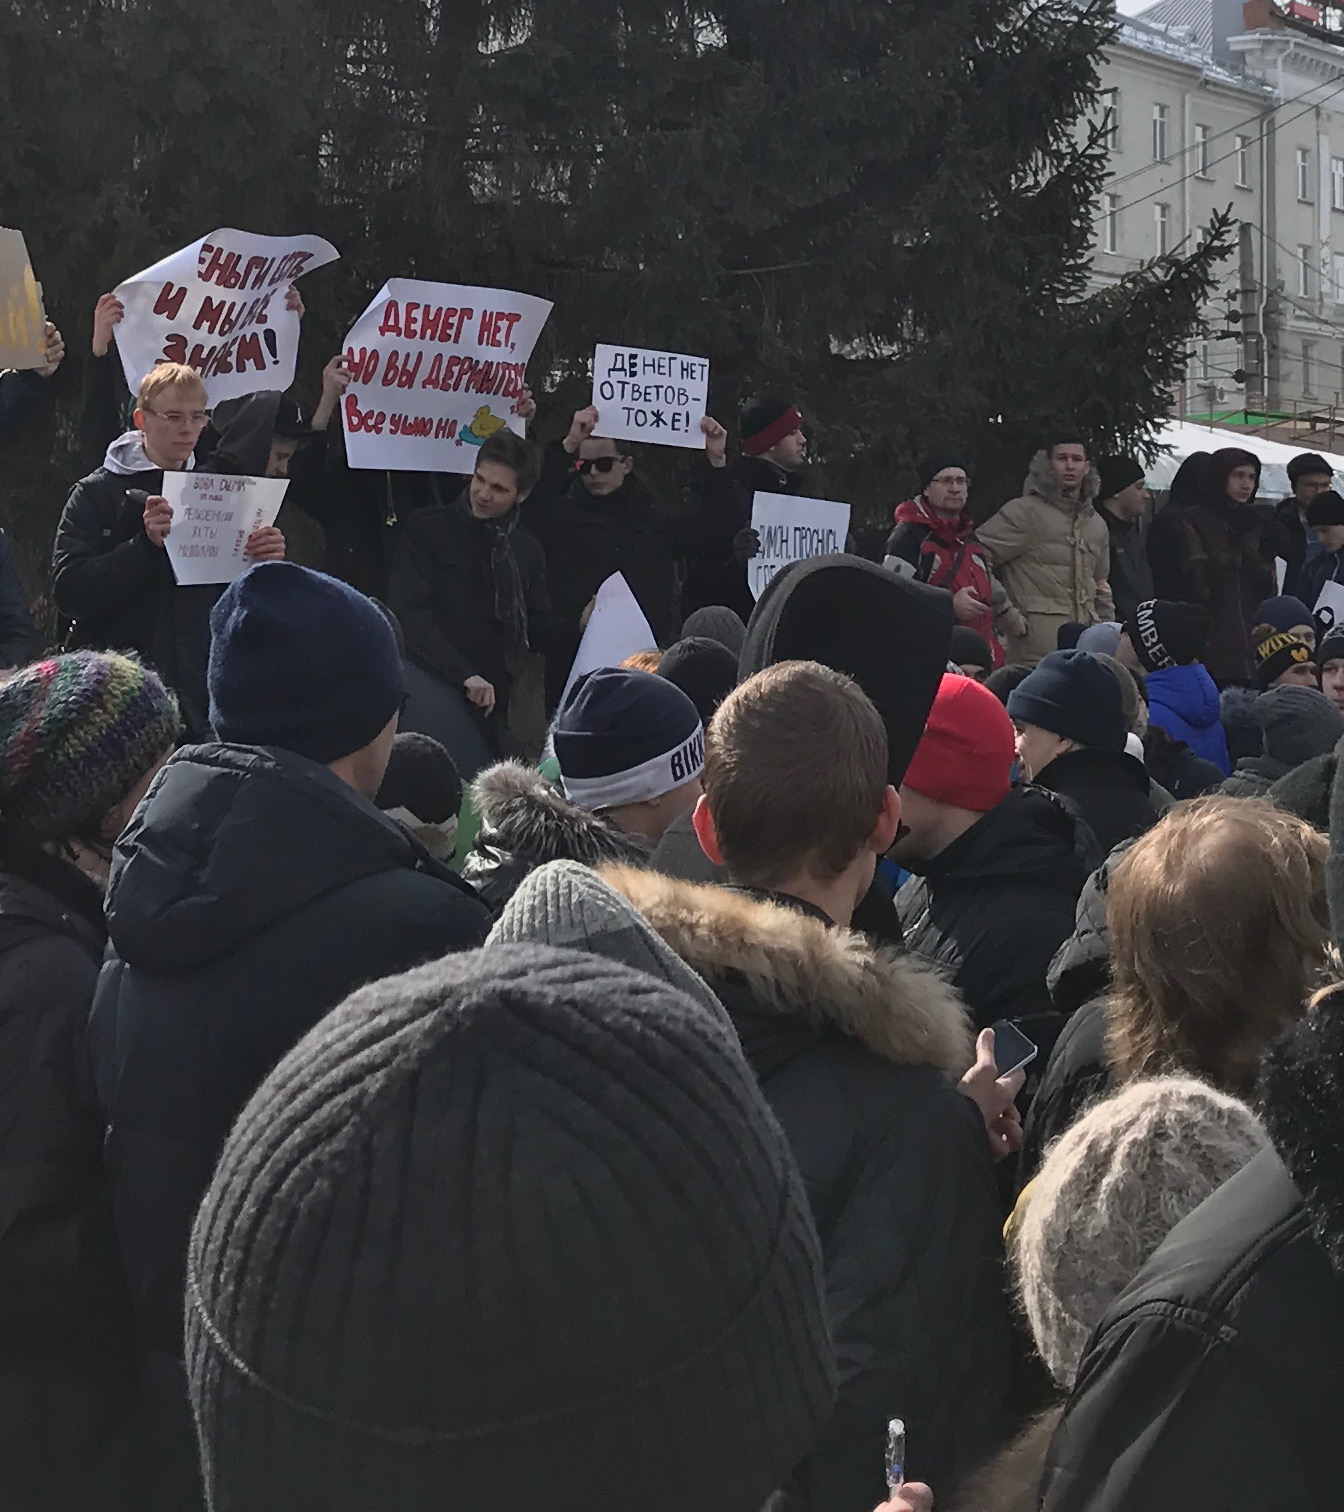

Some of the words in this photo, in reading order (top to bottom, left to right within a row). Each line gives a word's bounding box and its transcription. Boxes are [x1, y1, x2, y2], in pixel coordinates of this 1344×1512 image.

[197, 243, 276, 290] ЕНЬГИ
[153, 281, 188, 321] И
[192, 295, 247, 337] МЫ
[378, 300, 474, 344] ДЕНЕГ
[477, 309, 522, 354] НЕТ,
[346, 346, 380, 386] НО
[381, 349, 423, 389] ВЫ
[607, 353, 678, 378] ДЕНЕГ
[680, 360, 708, 382] НЕТ
[621, 407, 690, 433] ТОЖЕ!
